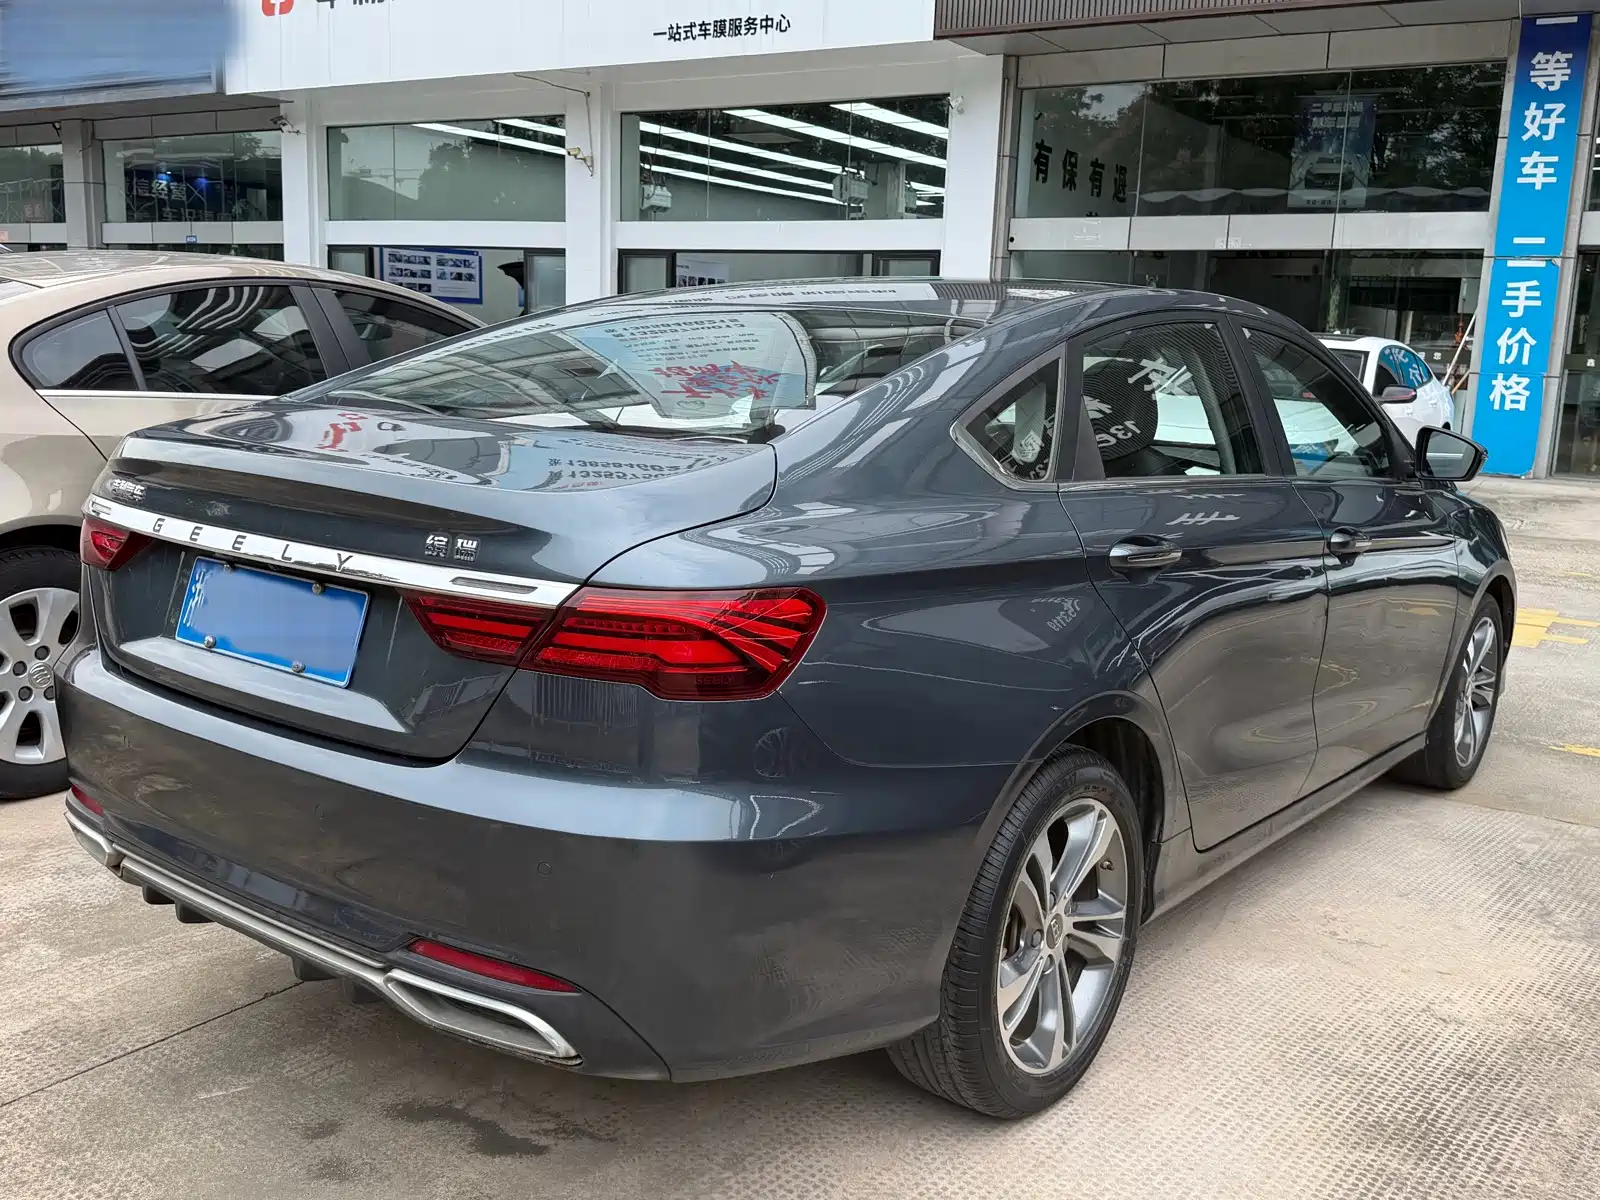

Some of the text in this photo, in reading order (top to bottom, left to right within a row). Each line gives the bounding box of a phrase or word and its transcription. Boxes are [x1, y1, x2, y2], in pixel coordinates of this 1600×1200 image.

[653, 14, 791, 42] 一站式车膜服务中心
[1488, 15, 1578, 412] 一等好车 二手价格
[152, 517, 354, 572] GEELY
